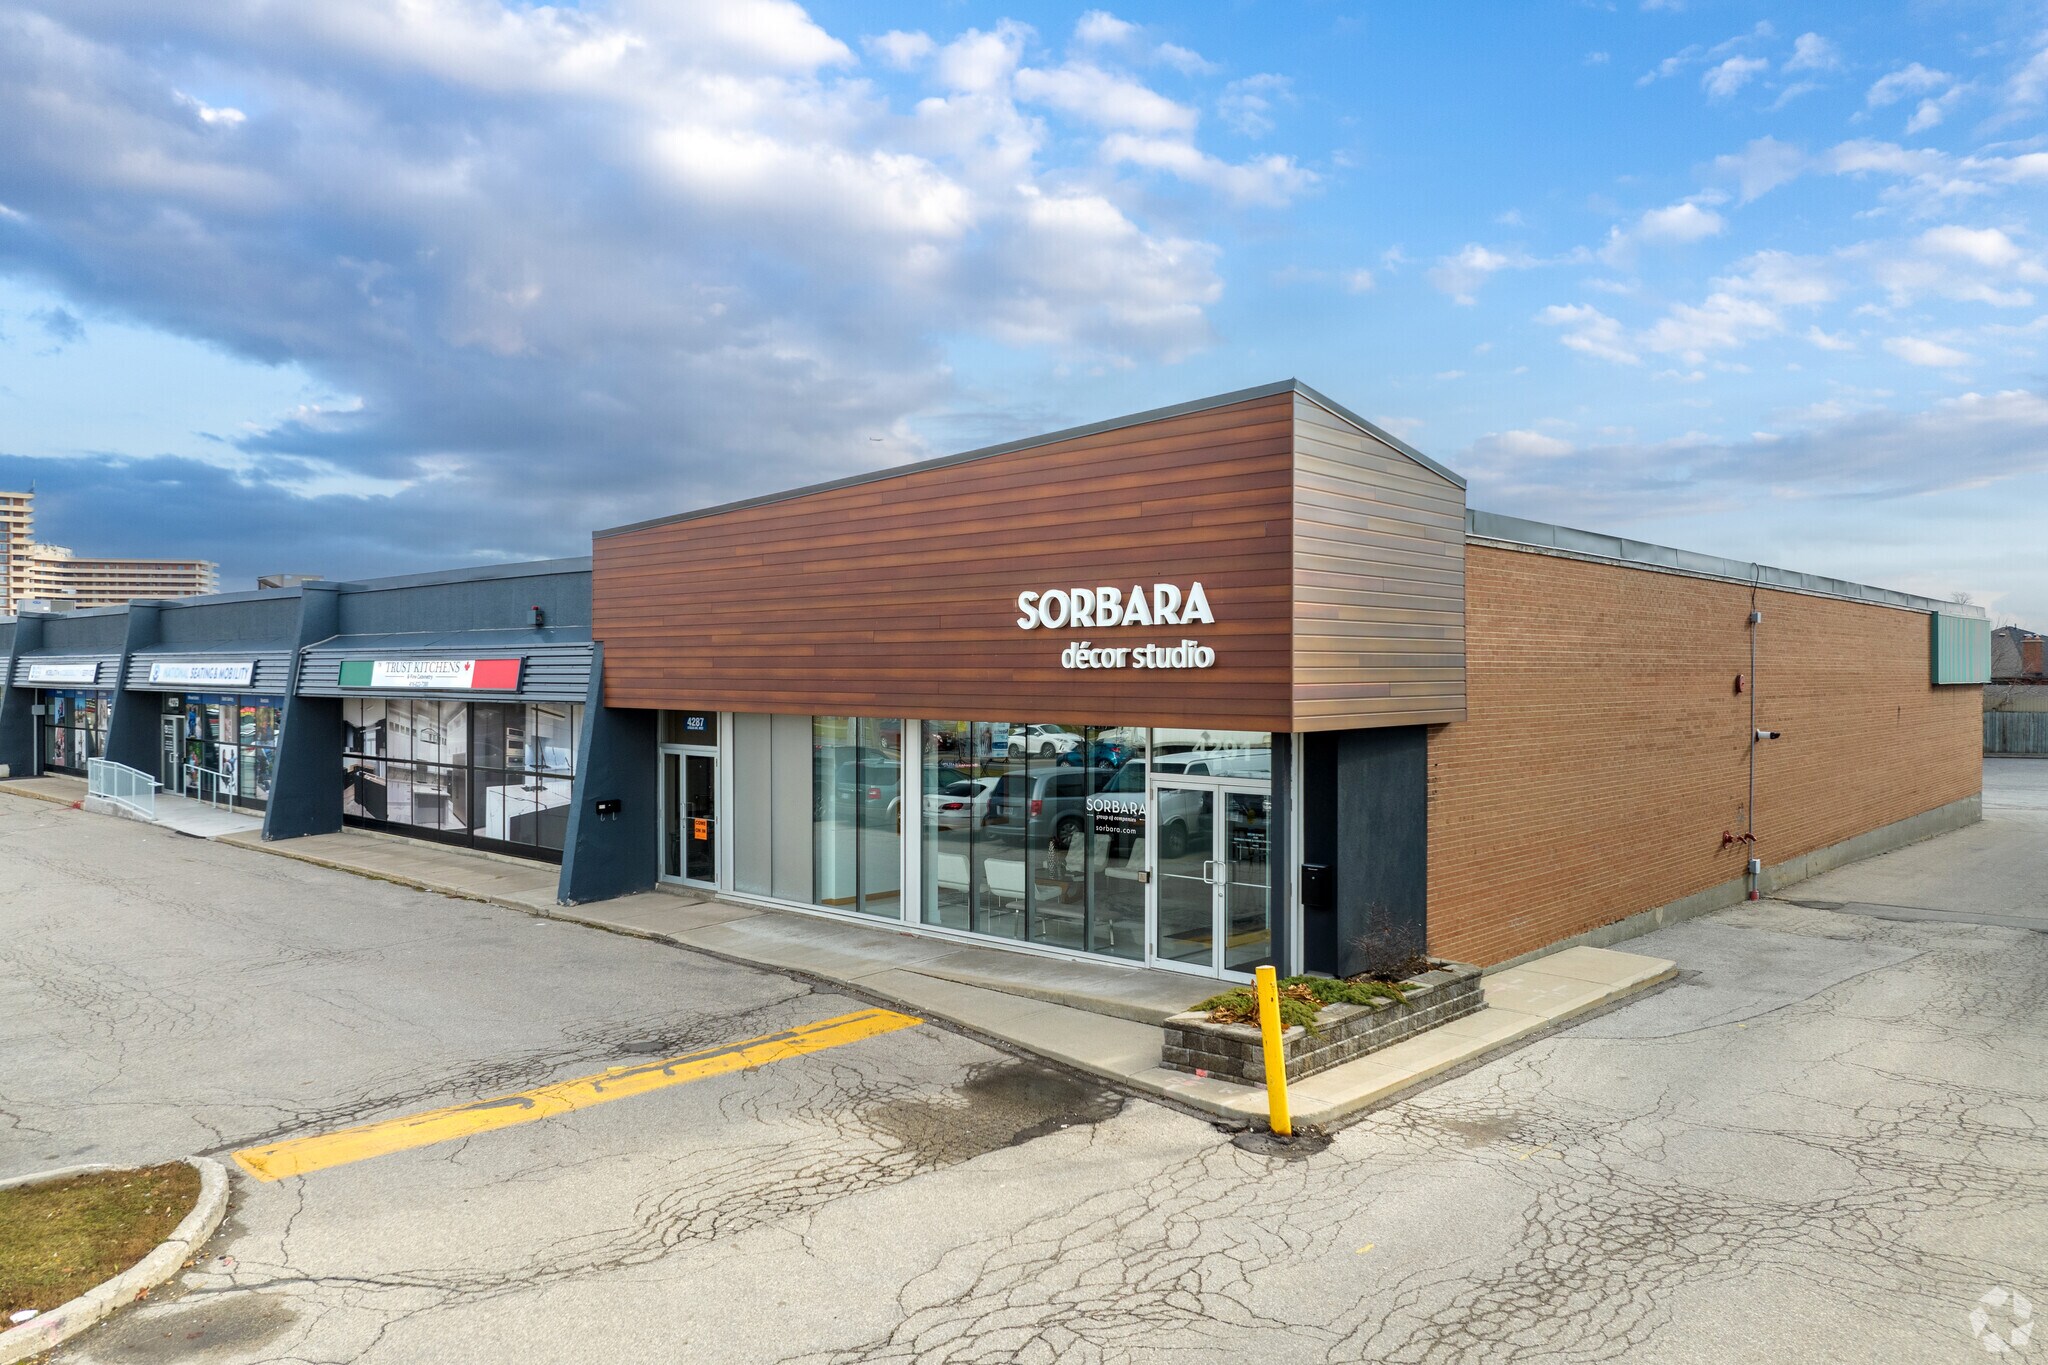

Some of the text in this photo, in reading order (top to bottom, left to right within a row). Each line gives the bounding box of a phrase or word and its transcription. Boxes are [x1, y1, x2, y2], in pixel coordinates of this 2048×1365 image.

[1016, 581, 1215, 630] SORBARA
[1061, 639, 1215, 669] décor studio
[163, 667, 189, 678] NATIONAL
[190, 667, 213, 679] SEATING
[219, 667, 249, 680] MOBILITY
[386, 661, 413, 673] TRUST
[413, 661, 461, 673] KITCHENS
[687, 717, 704, 726] 4287
[1192, 738, 1251, 762] 4291
[1086, 798, 1146, 816] SORBARA
[1095, 825, 1137, 834] sorbara.com
